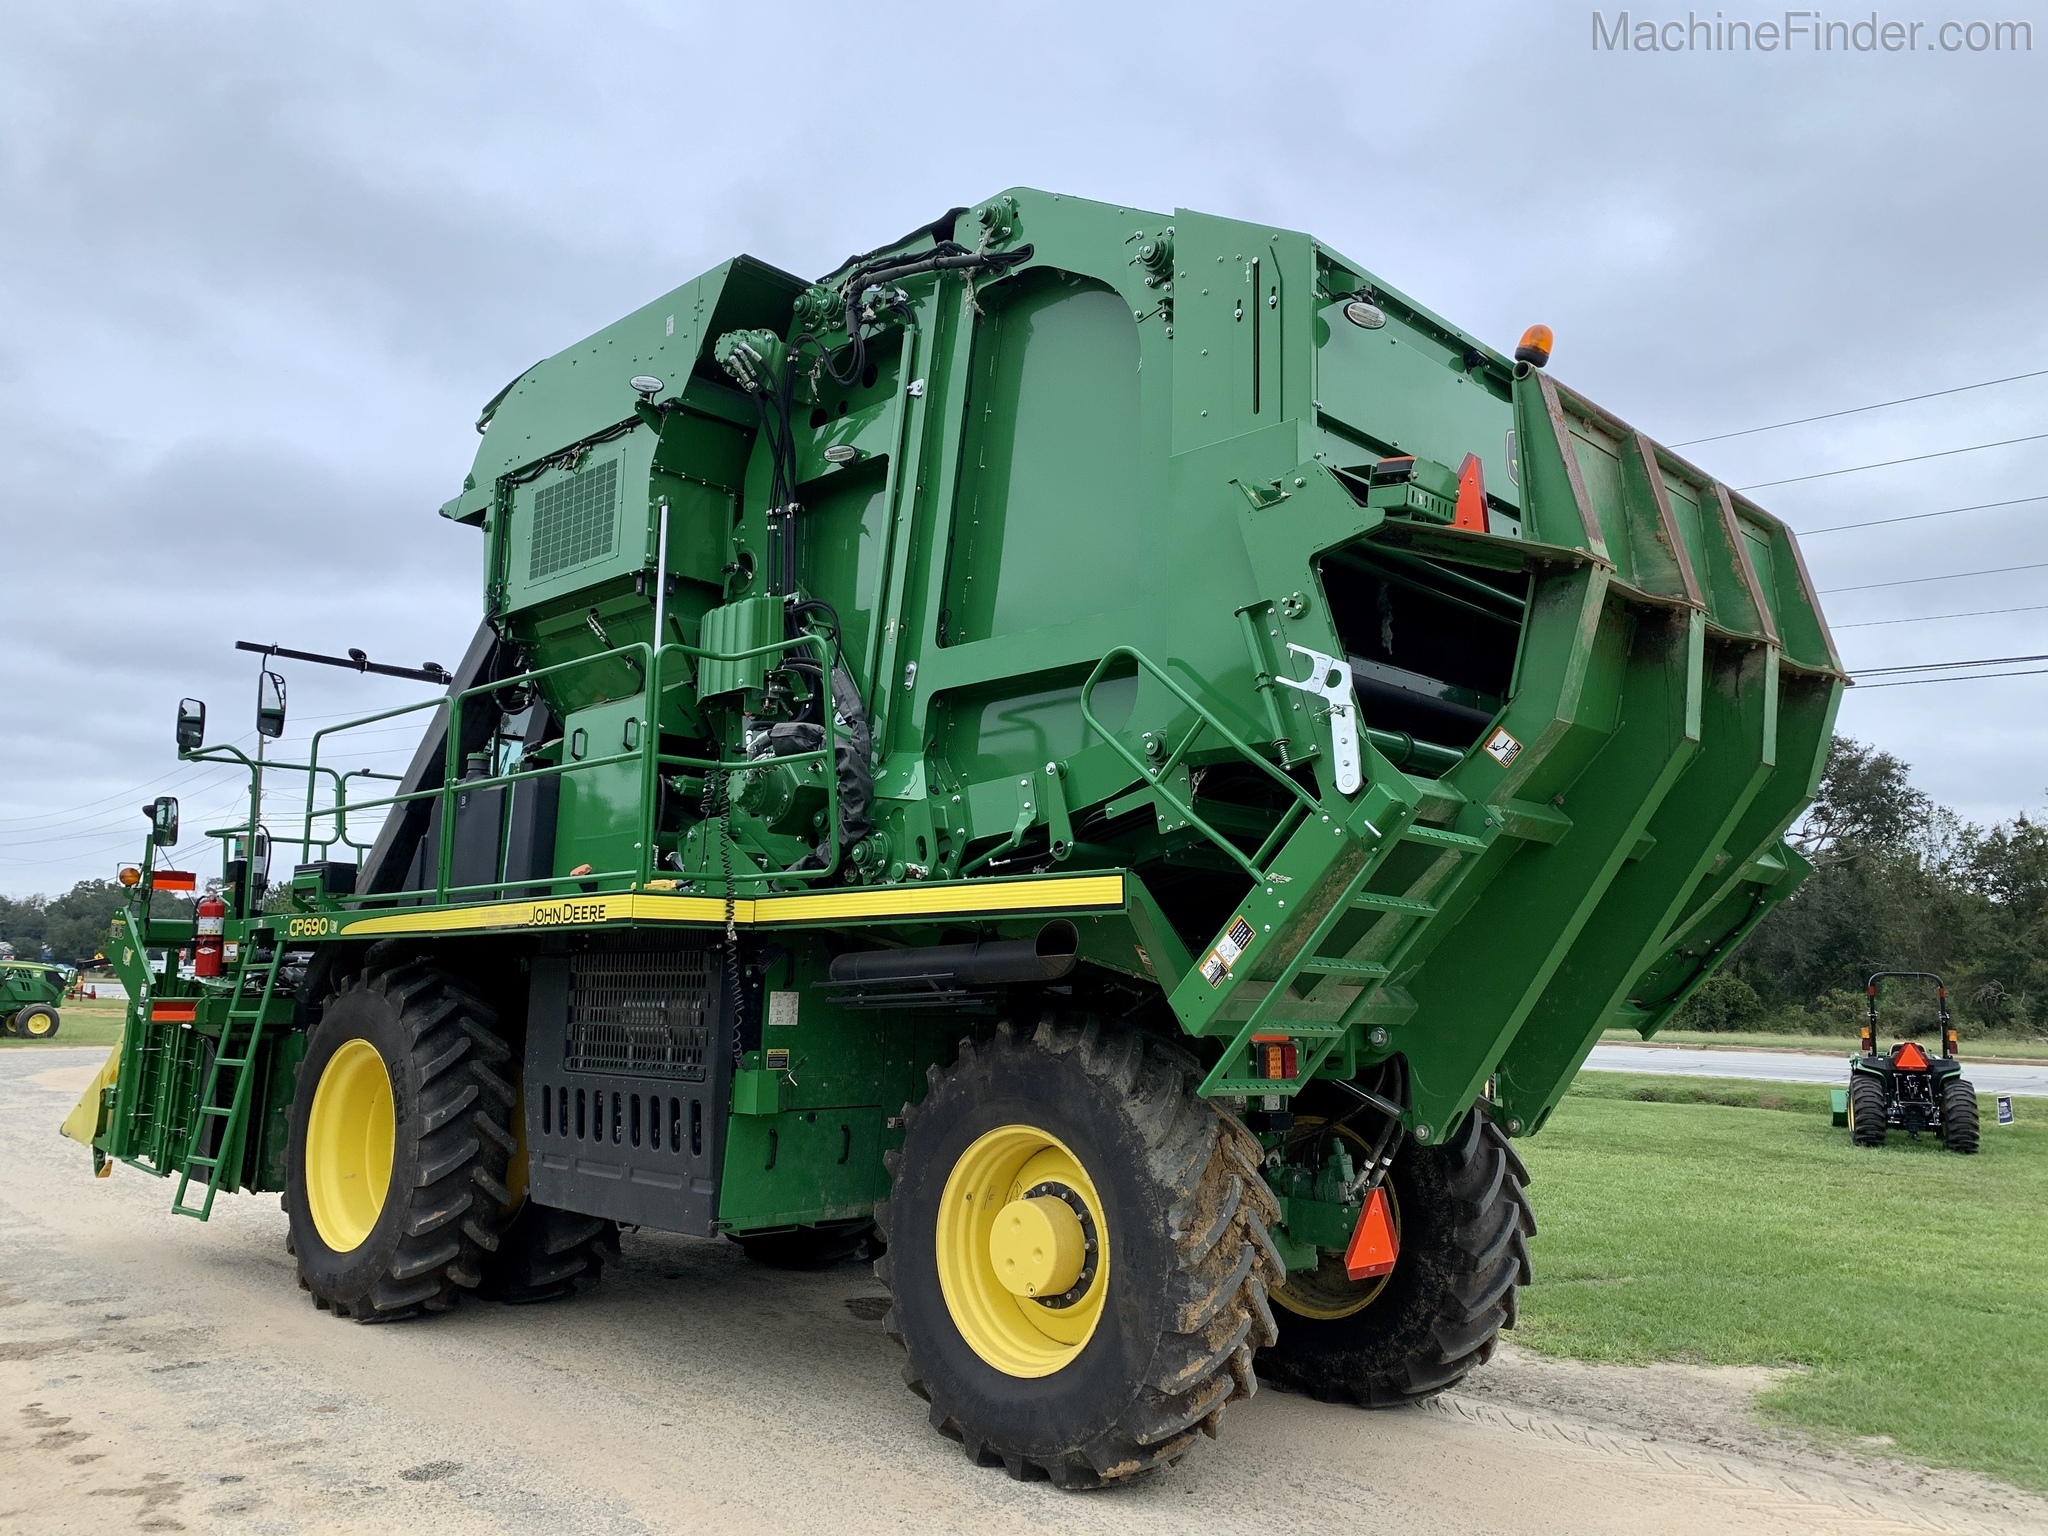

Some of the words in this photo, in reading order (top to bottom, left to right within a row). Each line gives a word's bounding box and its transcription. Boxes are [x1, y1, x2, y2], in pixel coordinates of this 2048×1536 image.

[528, 905, 562, 924] JOHN
[563, 903, 606, 921] DEERE
[290, 917, 328, 937] CP690
